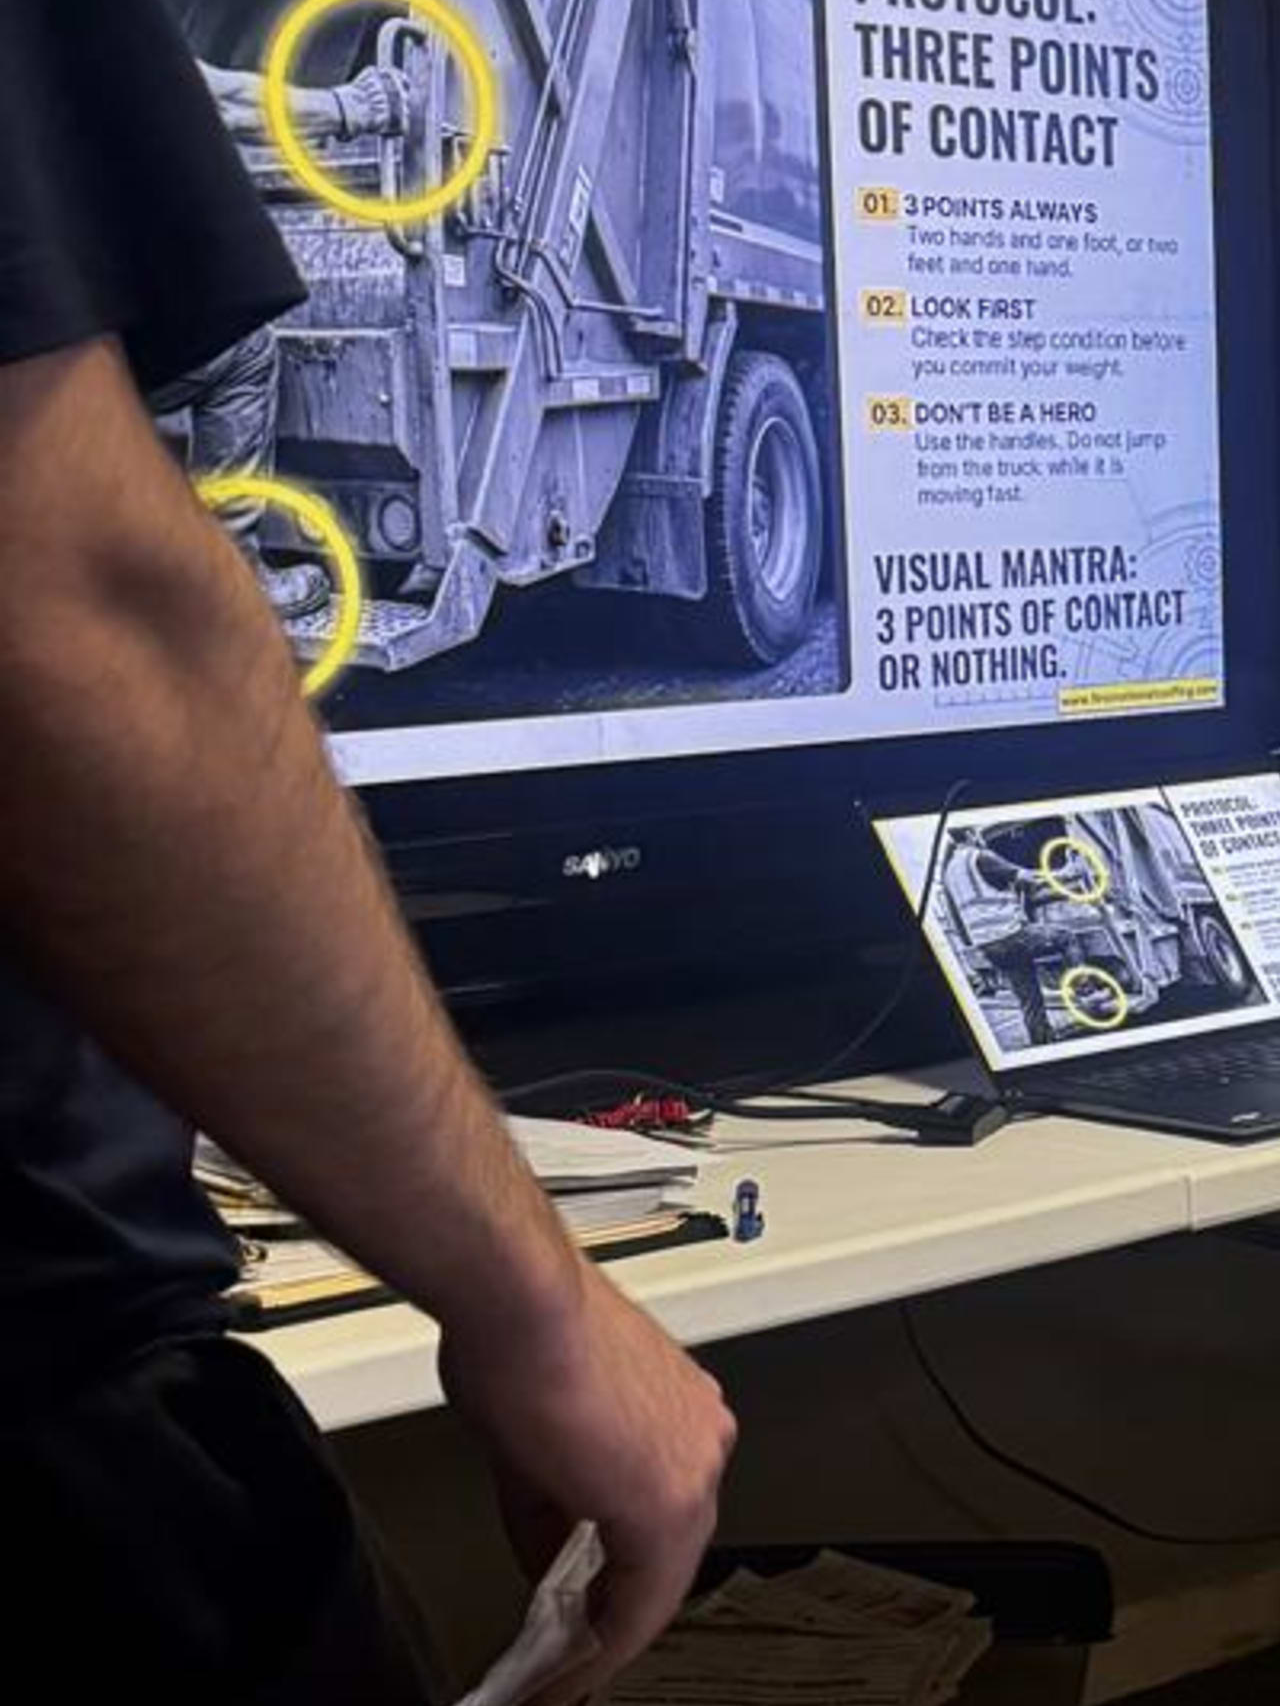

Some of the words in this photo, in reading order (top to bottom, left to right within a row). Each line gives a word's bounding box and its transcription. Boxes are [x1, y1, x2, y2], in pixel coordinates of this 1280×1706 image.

[854, 23, 995, 90] THREE
[1010, 37, 1159, 102] POINTS
[859, 99, 912, 155] OF
[930, 104, 1118, 167] CONTACT
[863, 192, 897, 215] 01.
[904, 195, 919, 217] 3
[922, 196, 1004, 219] POINTS
[1010, 200, 1099, 224] ALWAYS
[907, 225, 945, 245] Two
[950, 227, 1006, 248] hands
[1010, 230, 1041, 250] and
[1046, 234, 1079, 252] one
[1083, 231, 1124, 256] foot,
[1126, 237, 1144, 253] or
[1148, 236, 1179, 253] two
[908, 253, 944, 274] feet
[949, 254, 983, 275] and
[988, 259, 1021, 277] one
[1026, 256, 1073, 278] hand.
[867, 295, 904, 318] 02.
[911, 296, 972, 320] LOOK
[978, 298, 1037, 320] FIRST
[911, 327, 970, 351] Check
[972, 327, 1001, 349] the
[1006, 328, 1047, 356] step
[1049, 328, 1128, 352] condition
[1131, 329, 1188, 352] before
[911, 357, 946, 381] you
[950, 353, 1017, 376] commit
[1020, 357, 1058, 381] your
[871, 403, 909, 426] 03.
[914, 402, 983, 425] DON'T
[988, 403, 1015, 424] BE
[1019, 403, 1036, 424] A
[1040, 402, 1097, 424] HERO
[915, 432, 951, 452] Use
[955, 431, 984, 451] the
[988, 429, 1059, 450] handles.
[1068, 429, 1092, 450] Do
[1093, 429, 1123, 450] not
[1126, 429, 1167, 454] jump
[917, 459, 958, 479] from
[962, 457, 994, 478] the
[998, 457, 1042, 478] truck
[1047, 454, 1090, 476] while
[1094, 455, 1106, 475] it
[1111, 455, 1125, 475] is
[917, 486, 984, 507] moving
[987, 483, 1024, 503] fast.
[873, 551, 990, 594] VISUAL
[1001, 545, 1138, 589] MANTRA:
[876, 608, 895, 645] 3
[906, 602, 1012, 643] POINTS
[1021, 599, 1055, 634] OF
[1064, 590, 1187, 633] CONTACT
[878, 653, 921, 691] OR
[931, 644, 1068, 689] NOTHING.
[562, 847, 642, 879] SANYO
